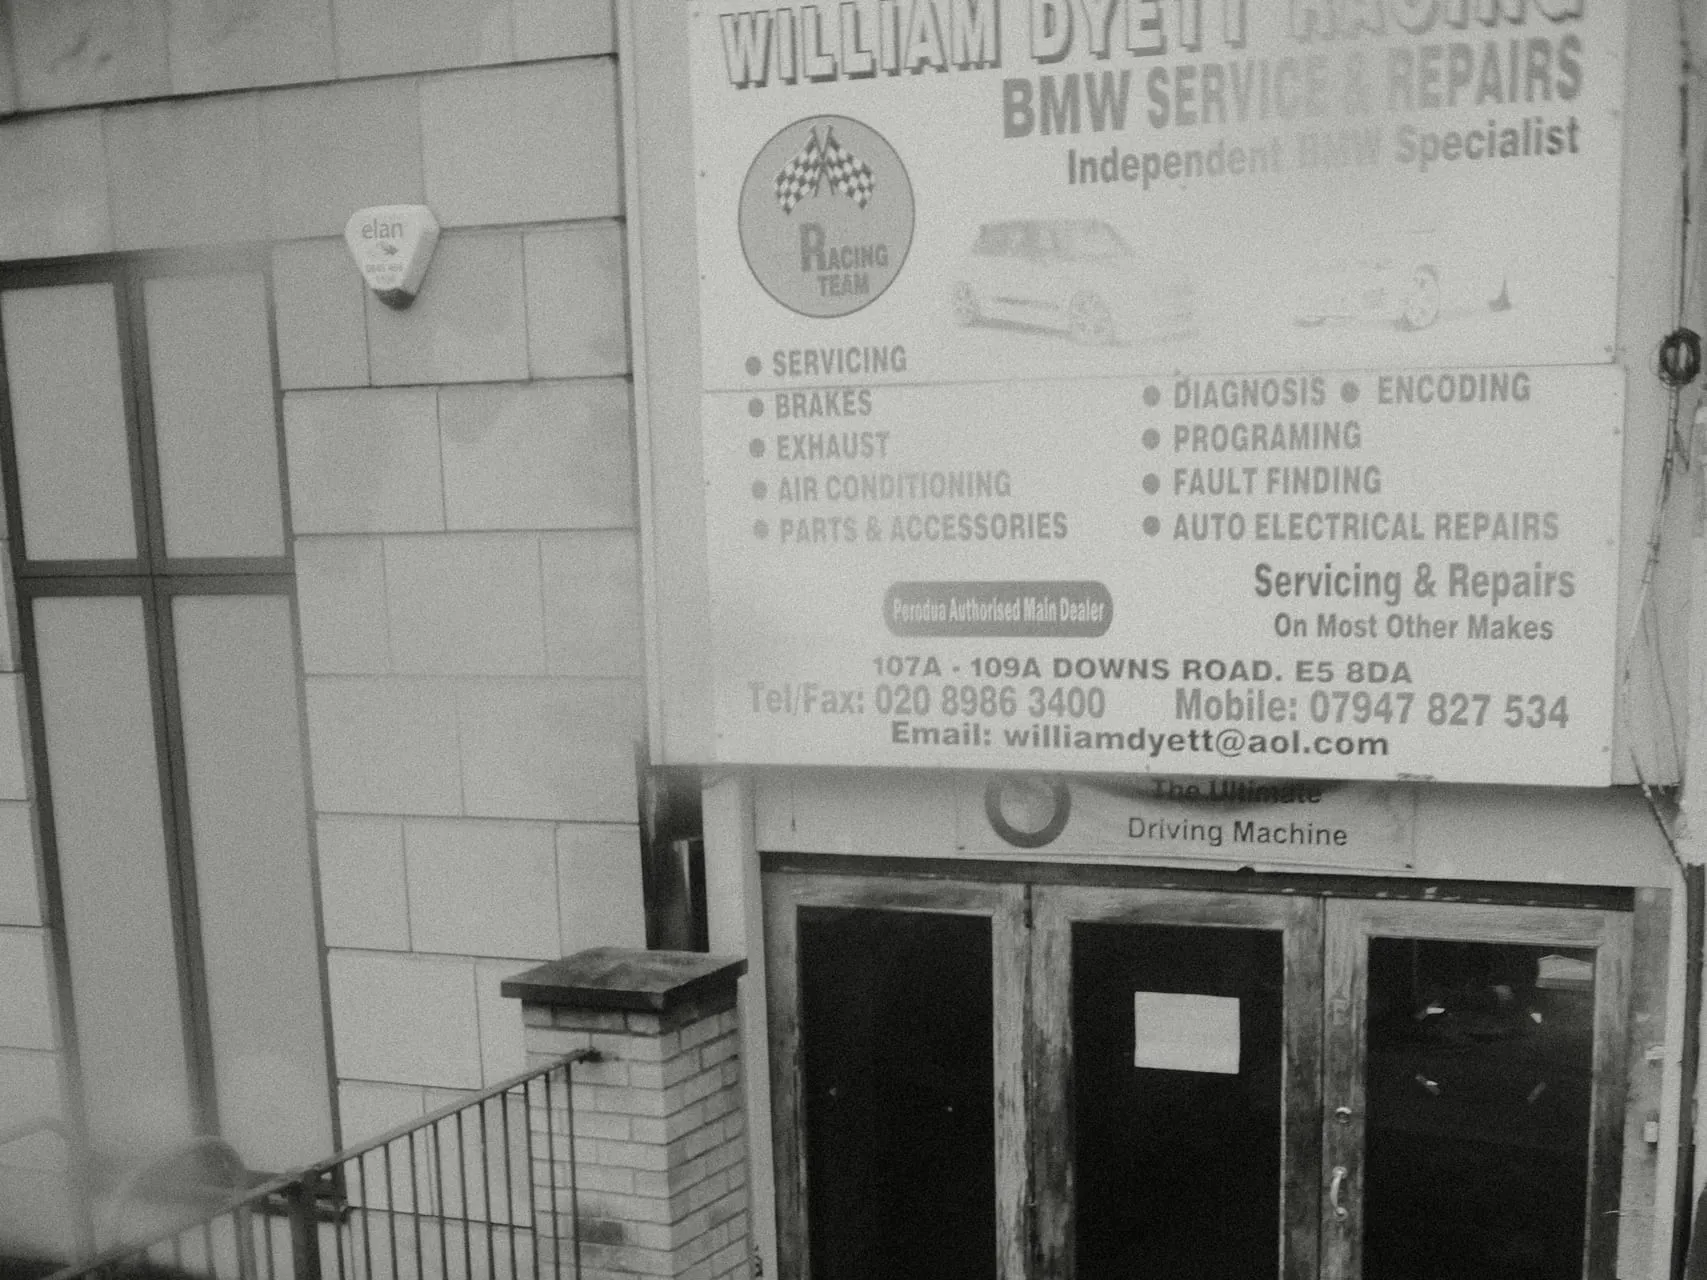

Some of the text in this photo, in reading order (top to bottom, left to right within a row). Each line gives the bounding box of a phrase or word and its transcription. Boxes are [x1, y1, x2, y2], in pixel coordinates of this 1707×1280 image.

[720, 0, 1001, 89] WILLIAM
[1003, 69, 1130, 139] BMW
[1146, 55, 1327, 128] SERVICE
[1388, 34, 1582, 111] REPAIRS
[1067, 138, 1281, 190] Independent
[1396, 115, 1580, 172] Specialist
[361, 218, 403, 239] elan
[818, 273, 870, 297] TEAM
[772, 345, 907, 377] SERVICING
[775, 389, 872, 418] BRAKES
[1174, 372, 1531, 409] DIAGNOSIS ENCODING
[777, 431, 890, 460] EXHAUST
[1174, 421, 1362, 453] PROGRAMING
[778, 469, 1012, 503] AIR CONDITIONING
[1173, 465, 1382, 496] FAULT FINDING
[780, 511, 1069, 544] PARTS & ACCESSORIES
[1173, 511, 1560, 541] AUTO ELECTRICAL REPAIRS
[1254, 561, 1576, 607] Servicing & Repairs
[949, 596, 1020, 621] Authorised
[1023, 596, 1057, 621] Main
[1060, 596, 1104, 621] Dealer
[1274, 612, 1555, 641] On Most Other Makes
[872, 655, 941, 677] 107A
[970, 656, 1042, 679] 109A
[1053, 657, 1170, 681] DOWNS
[1295, 661, 1335, 684] E5
[1347, 661, 1413, 685] 8DA
[751, 681, 1106, 719] Tel/Fax: 020 8986 3400
[1175, 687, 1569, 729] Mobile: 07947 827 534
[891, 720, 1389, 758] Email: williamdyett@aol.com
[1152, 778, 1200, 800] The
[1127, 816, 1348, 848] Driving Machine
